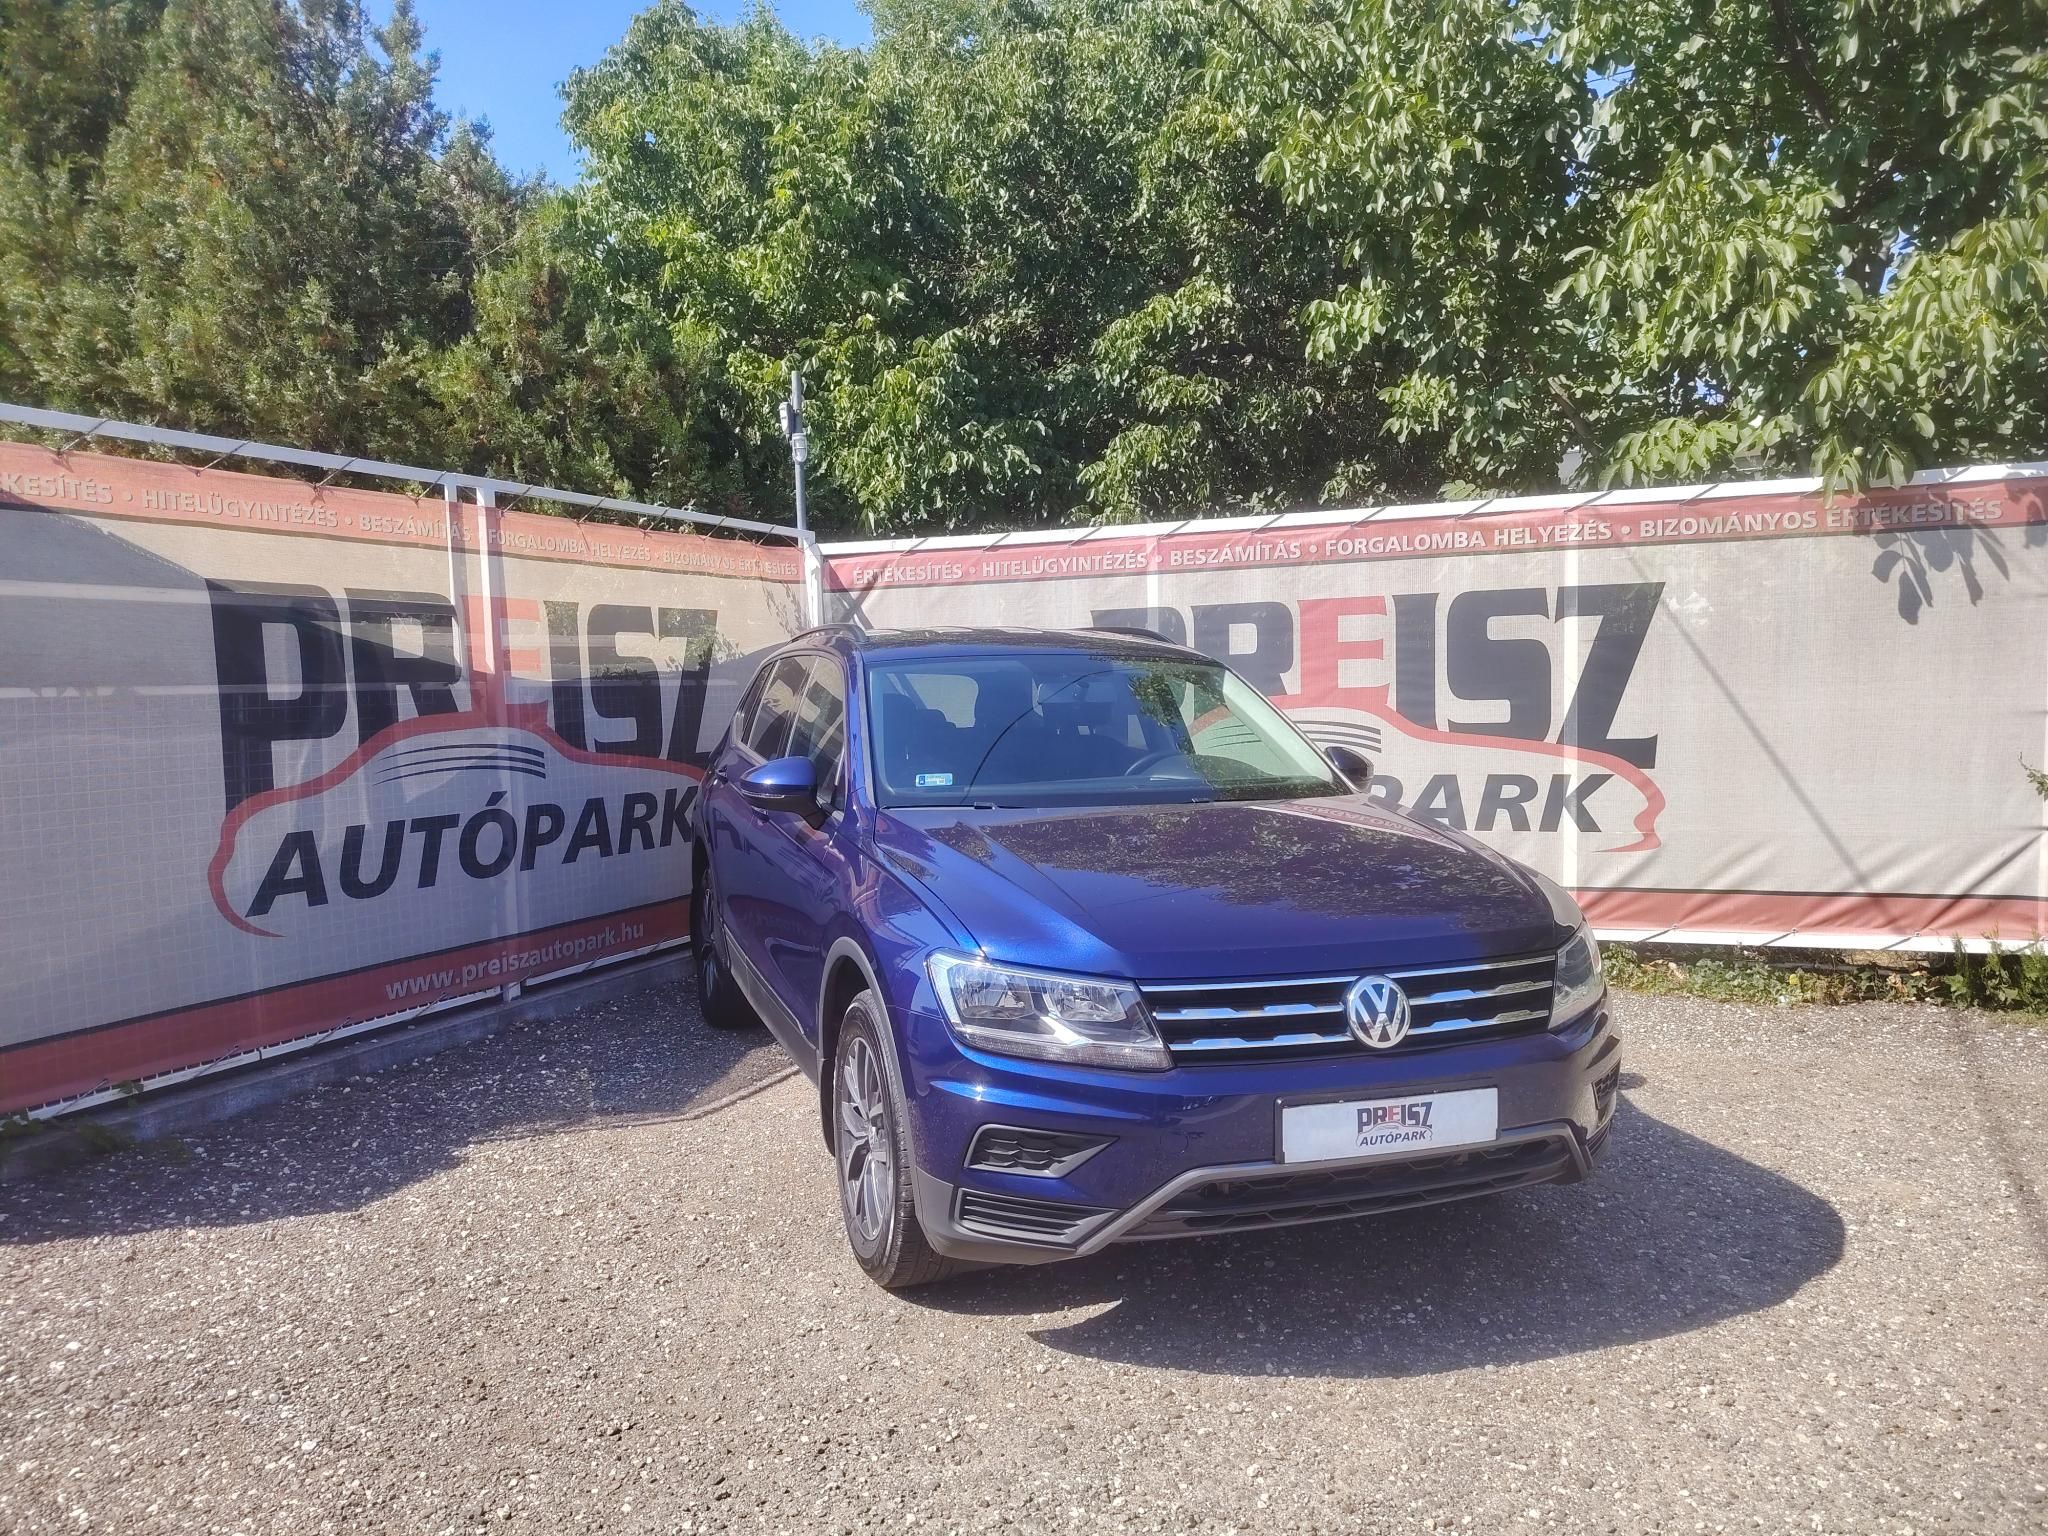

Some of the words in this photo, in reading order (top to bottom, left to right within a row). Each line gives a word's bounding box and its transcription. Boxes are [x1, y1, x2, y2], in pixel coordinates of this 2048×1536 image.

[144, 489, 339, 528] HITELÜGYINTÉZÉS
[488, 528, 588, 554] FORGALOMBA
[591, 542, 651, 561] HELYEZÉS
[853, 561, 963, 585] ÉRTÉKESÍTÉS
[983, 551, 1148, 578] HITELÜGYINTÉZÉS
[1170, 541, 1302, 567] BESZÁMÍTÁS
[1325, 530, 1487, 557] FORGALOMBA
[1494, 519, 1613, 546] HELYEZÉS
[1639, 507, 1818, 538] BIZOMÁNYOS
[1826, 498, 2003, 527] ÉRTÉKESÍTÉS
[205, 577, 718, 811] PREISZ
[245, 785, 699, 917] AUTÓPARK
[385, 922, 644, 1001] www.preiszautopark.hu
[1357, 1102, 1432, 1133] PREISZ
[1360, 1130, 1427, 1147] AUTÓPARK
